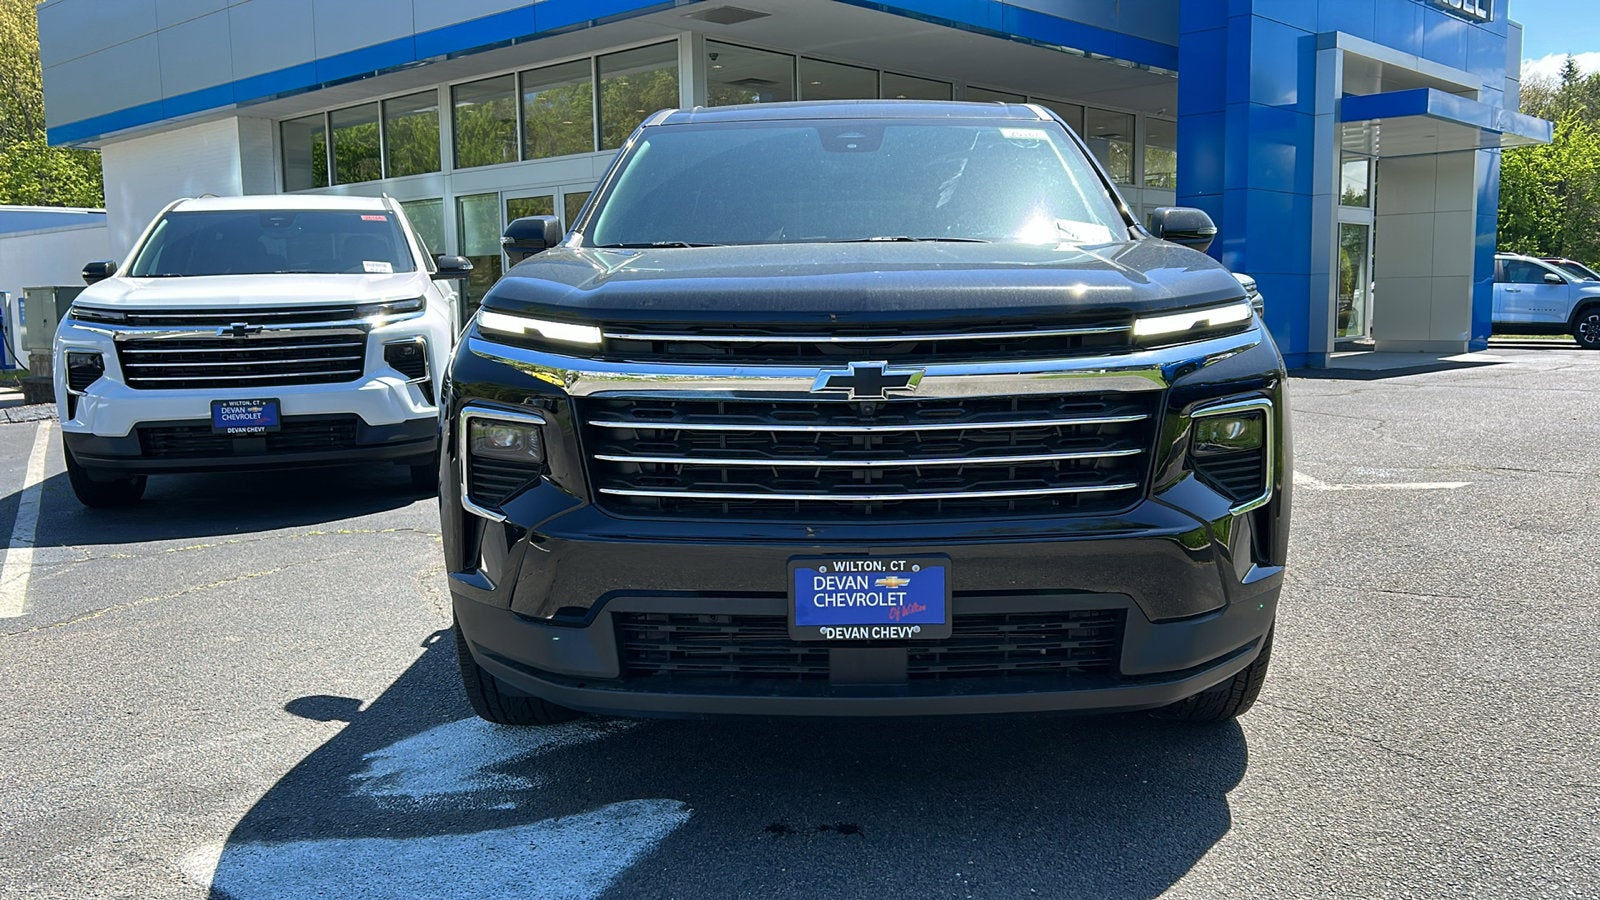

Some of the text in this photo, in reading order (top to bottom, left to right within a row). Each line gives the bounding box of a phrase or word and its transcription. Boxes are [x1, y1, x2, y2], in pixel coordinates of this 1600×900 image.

[833, 560, 906, 572] WILTON, CT
[813, 575, 869, 591] DEVAN
[813, 592, 907, 608] CHEVROLET
[826, 626, 914, 639] DEVAN CHEVY
